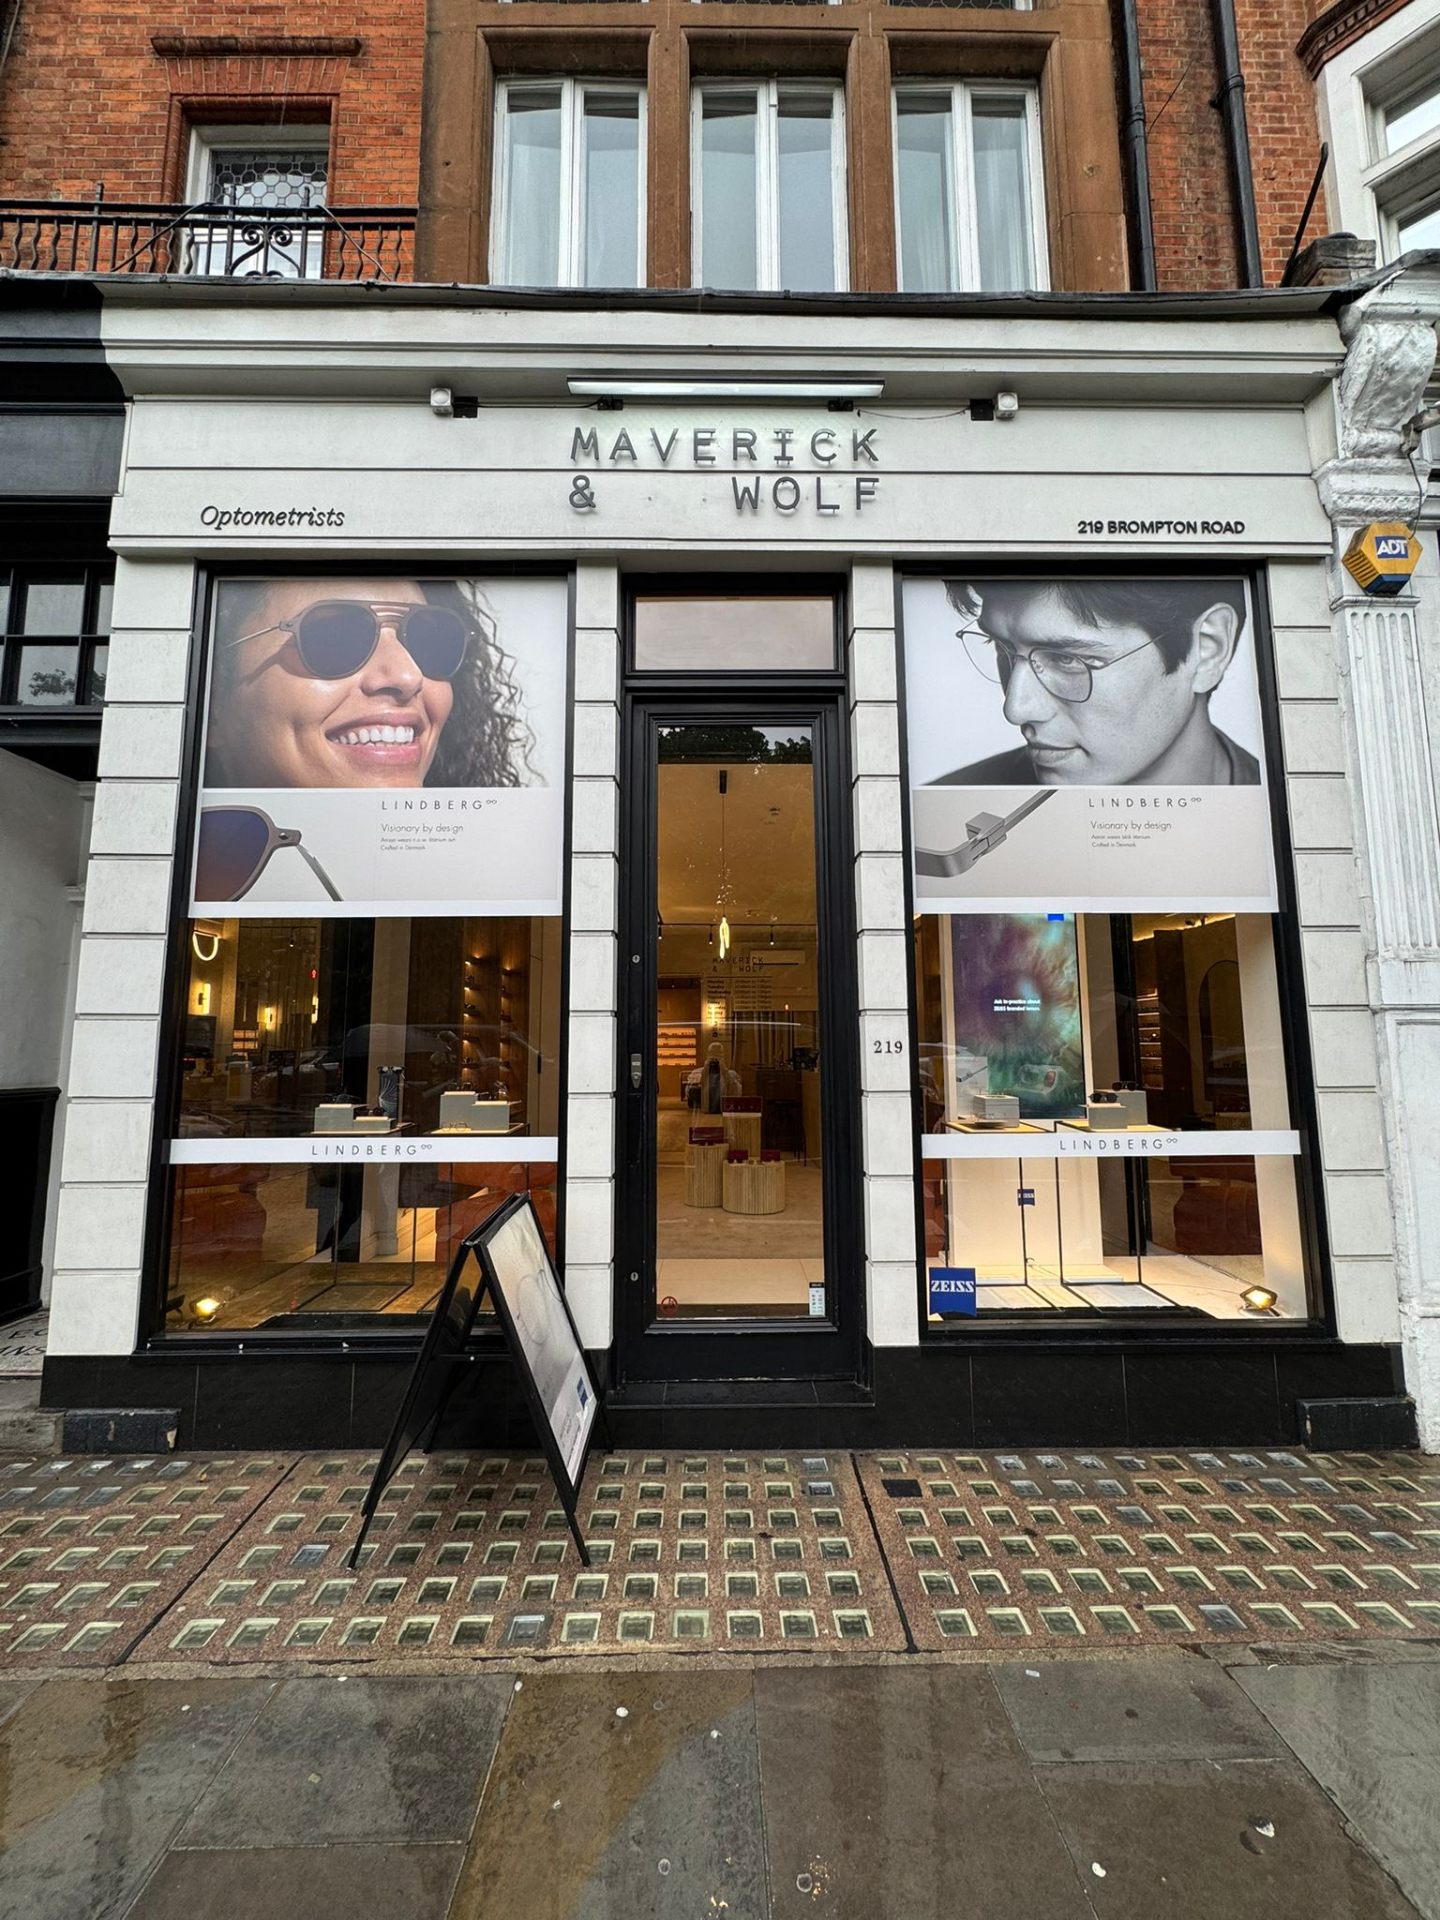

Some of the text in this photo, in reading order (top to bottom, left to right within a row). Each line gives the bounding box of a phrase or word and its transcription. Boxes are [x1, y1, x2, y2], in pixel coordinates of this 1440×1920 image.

[571, 427, 879, 462] MAVERICK
[569, 475, 879, 511] & WOLF
[200, 505, 345, 530] Optometrists
[1077, 520, 1246, 534] 219 BROMPTON ROAD
[1376, 539, 1408, 555] ADT
[381, 800, 482, 810] LINDBERG
[1088, 798, 1187, 808] LINDBERG
[381, 823, 463, 835] Visionary by design
[1090, 820, 1171, 832] Visionary by design
[873, 1040, 903, 1054] 219
[311, 1145, 416, 1155] LINDBERG
[1060, 1139, 1162, 1150] LINDBERG
[931, 1280, 975, 1293] ZEISS
